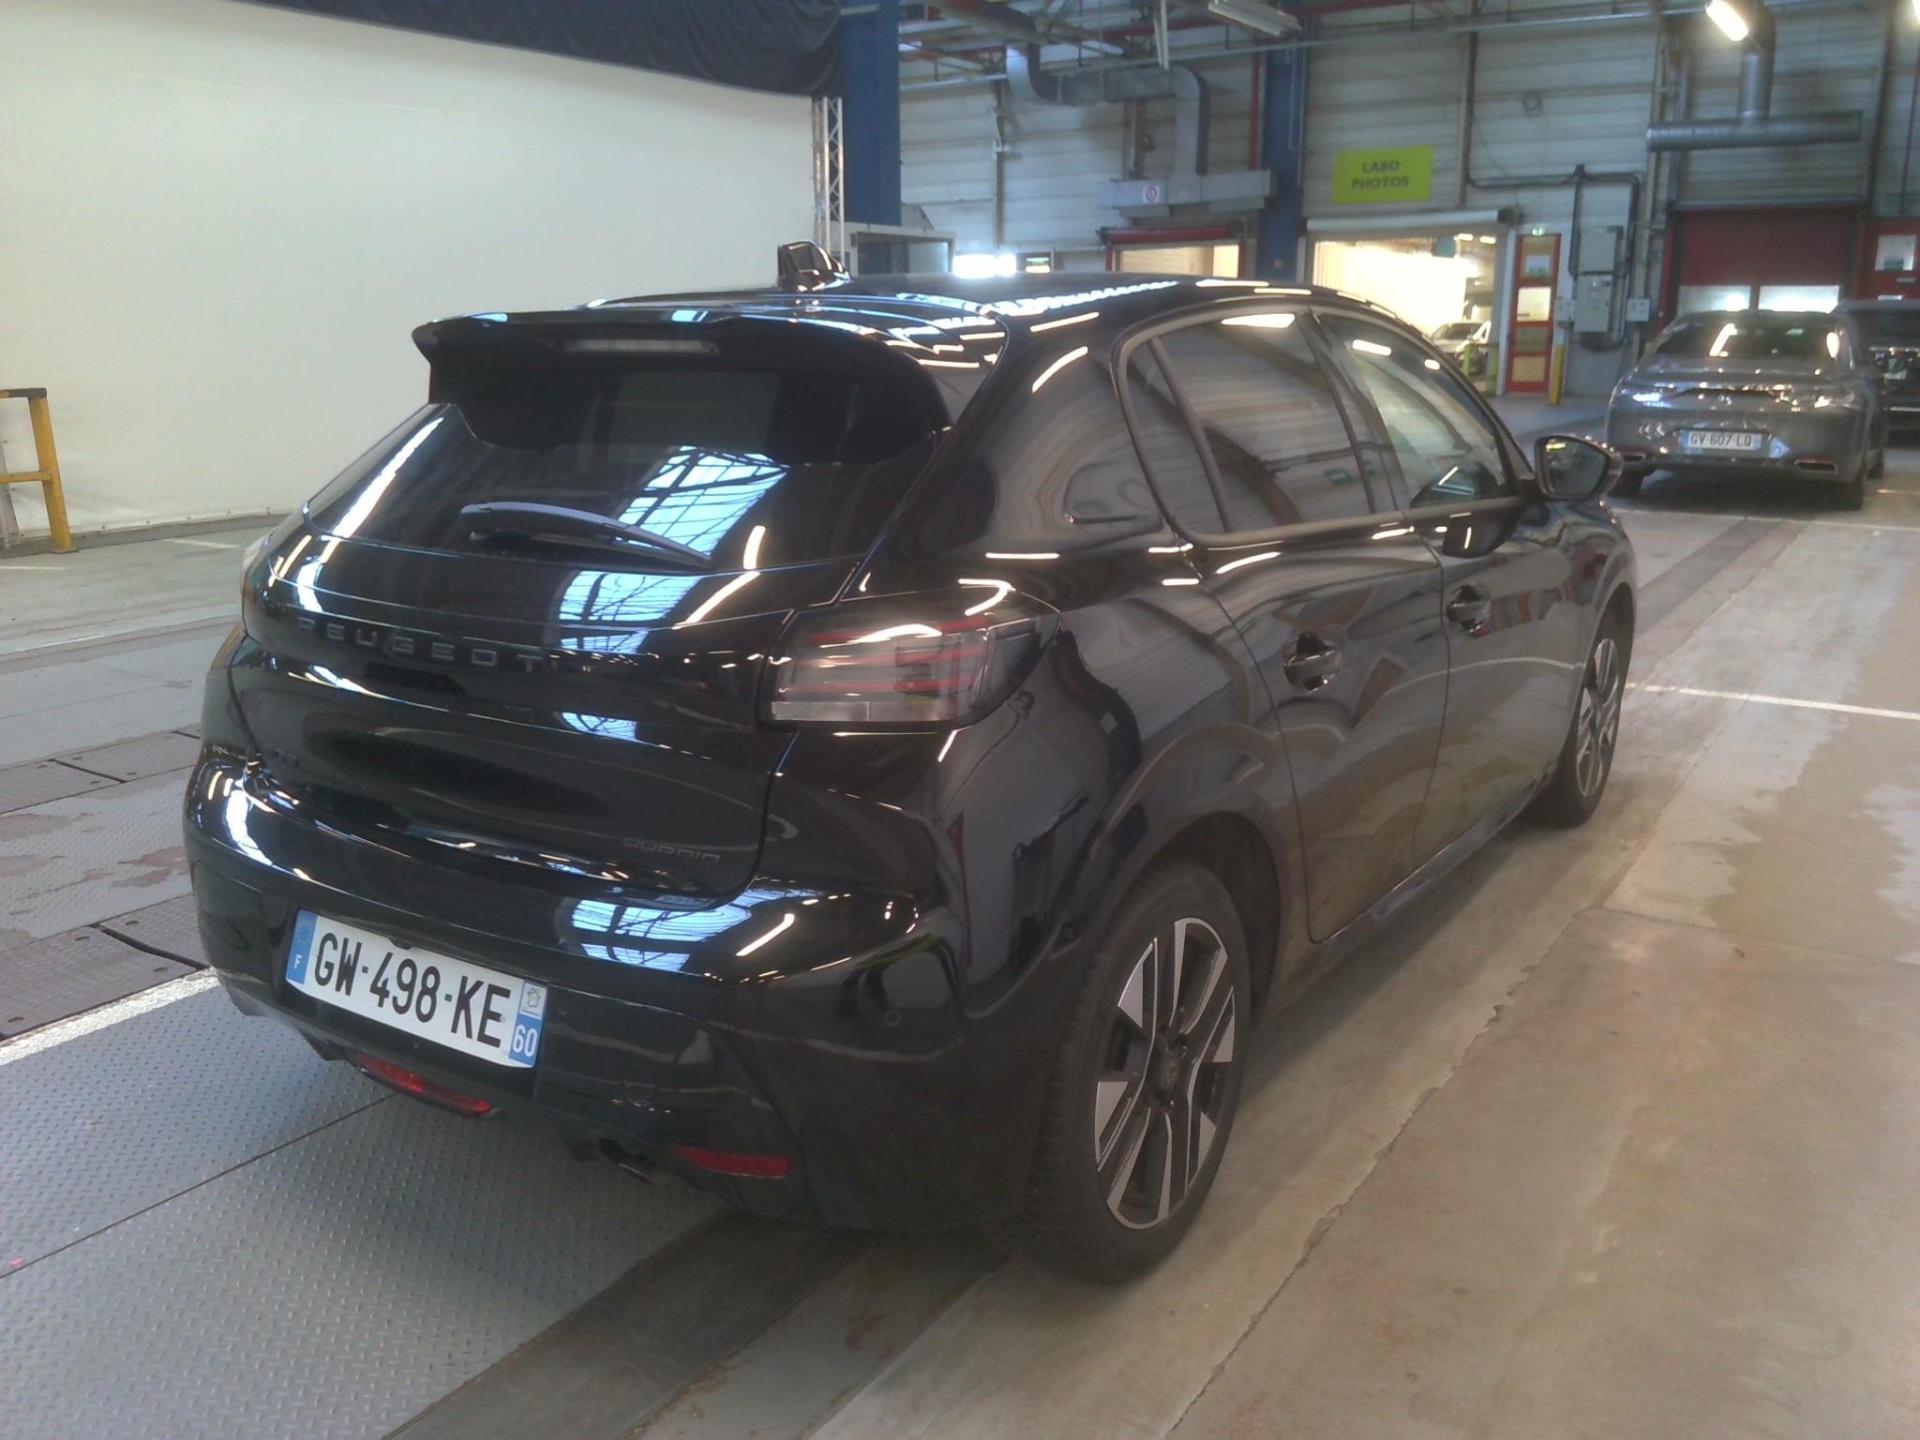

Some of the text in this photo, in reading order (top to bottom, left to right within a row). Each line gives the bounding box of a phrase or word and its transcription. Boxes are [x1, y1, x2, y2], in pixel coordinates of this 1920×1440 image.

[1361, 160, 1400, 173] LABO
[1351, 176, 1409, 190] PHOTOS
[300, 616, 543, 673] PEUGEOT
[294, 954, 302, 969] F
[314, 932, 511, 1048] GW-498-KE
[511, 1024, 538, 1057] 60
